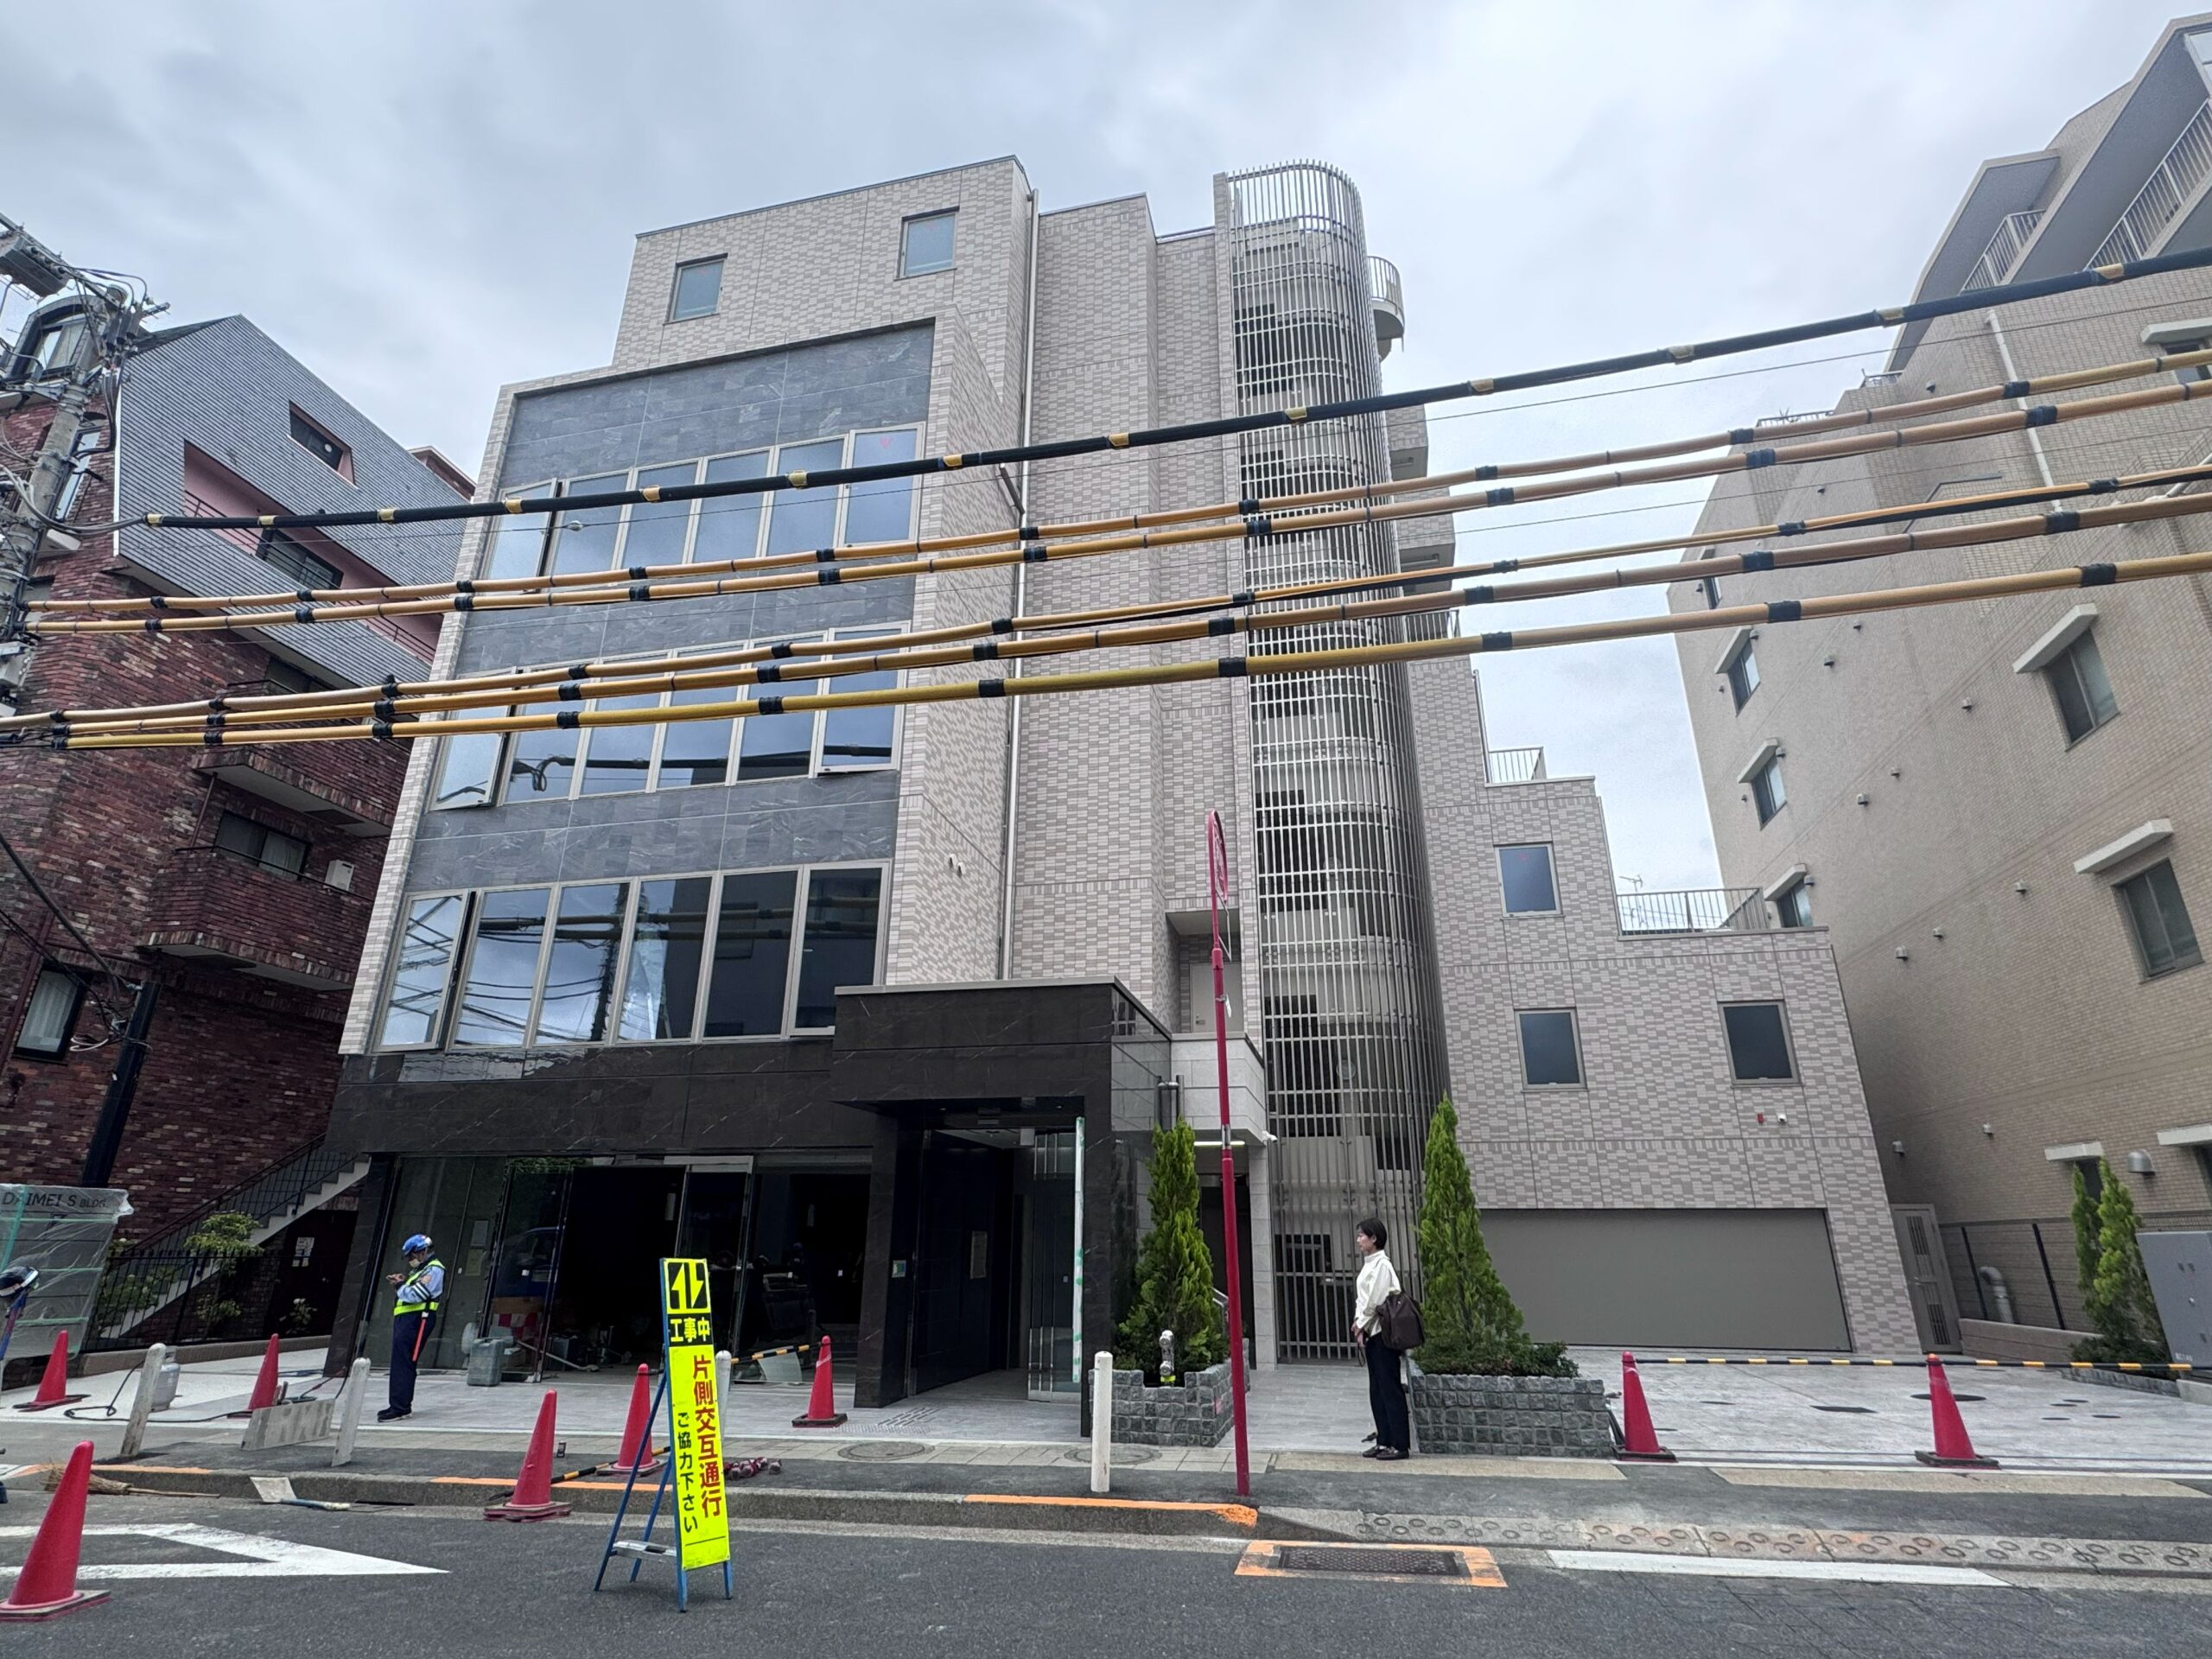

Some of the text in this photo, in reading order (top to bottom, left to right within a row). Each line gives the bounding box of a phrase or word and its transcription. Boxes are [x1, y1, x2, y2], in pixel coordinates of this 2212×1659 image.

[670, 1316, 711, 1343] 工事中
[677, 1411, 698, 1534] ご協力下さい
[692, 1354, 722, 1519] 片側交互通行
